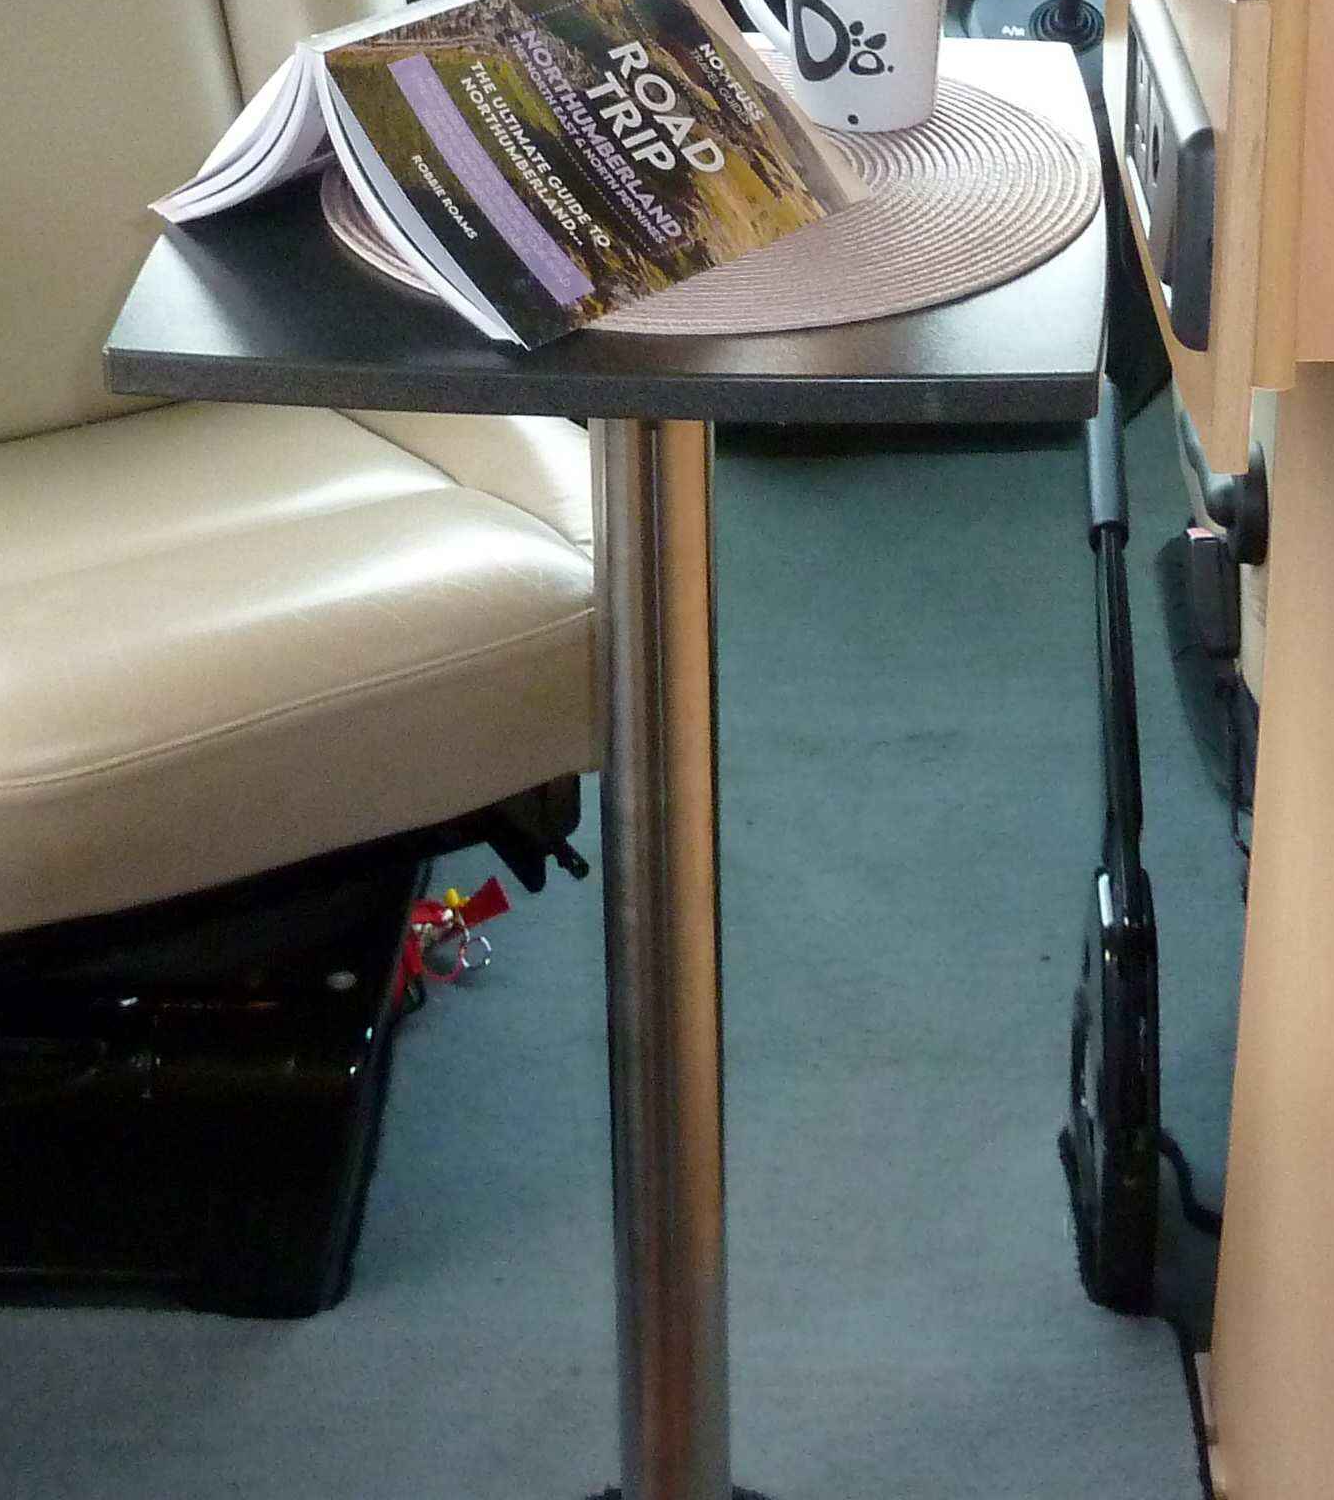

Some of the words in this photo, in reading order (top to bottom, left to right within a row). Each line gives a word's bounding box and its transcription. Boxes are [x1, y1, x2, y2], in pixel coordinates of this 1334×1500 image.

[507, 34, 532, 65] THE
[523, 61, 558, 106] NORTH
[551, 105, 580, 137] EAST
[573, 136, 588, 149] &
[581, 147, 620, 191] NORTH
[614, 188, 665, 245] PENNINES
[518, 29, 682, 237] NORTHUMBERLAND
[585, 71, 676, 171] TRIP
[607, 40, 726, 173] ROAD
[690, 46, 720, 89] TRAVEL
[718, 86, 751, 126] GUIDES
[698, 42, 724, 70] NO
[726, 80, 764, 121] FUSS
[410, 154, 447, 198] ROBBIE
[441, 196, 478, 240] ROAMS
[469, 60, 497, 94] THE
[490, 95, 551, 174] ULTIMATE
[546, 173, 592, 225] GUIDE
[588, 223, 610, 247] TO
